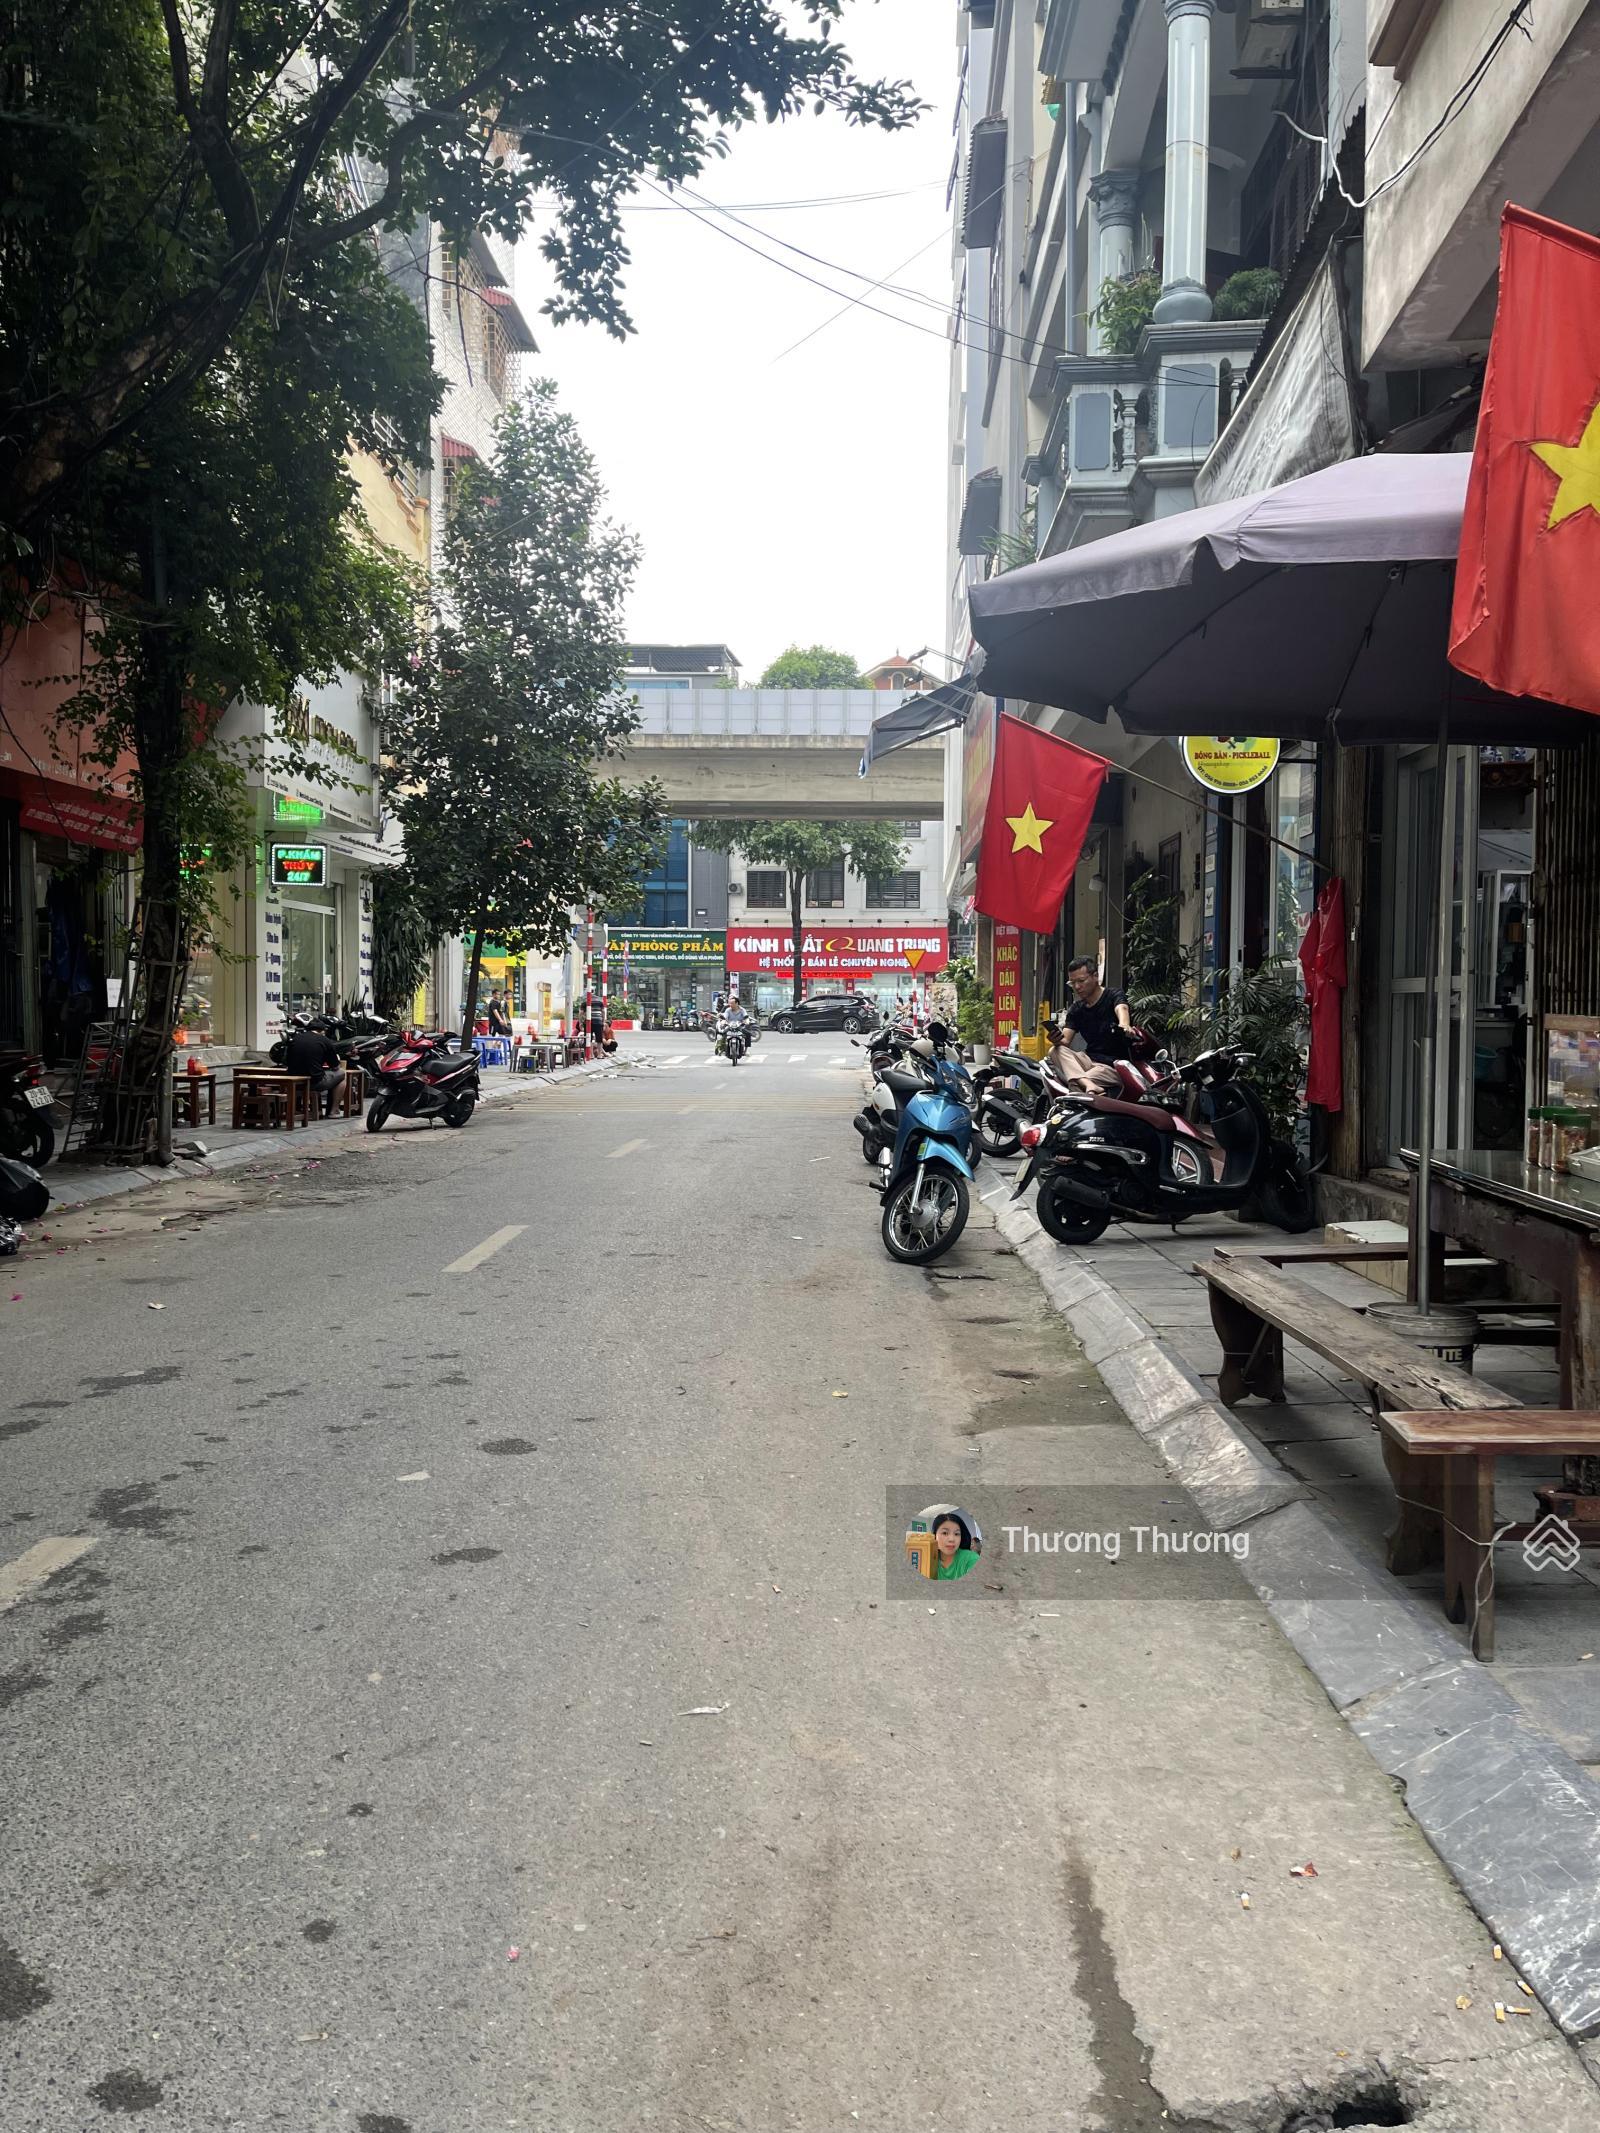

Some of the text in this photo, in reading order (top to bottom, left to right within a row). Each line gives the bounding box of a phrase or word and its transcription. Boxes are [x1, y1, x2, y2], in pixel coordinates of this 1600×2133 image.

[1232, 751, 1271, 759] PICKLEBALL
[631, 939, 679, 952] PHÒNG
[682, 937, 724, 952] PHẨM
[880, 957, 911, 968] NGHIỆ
